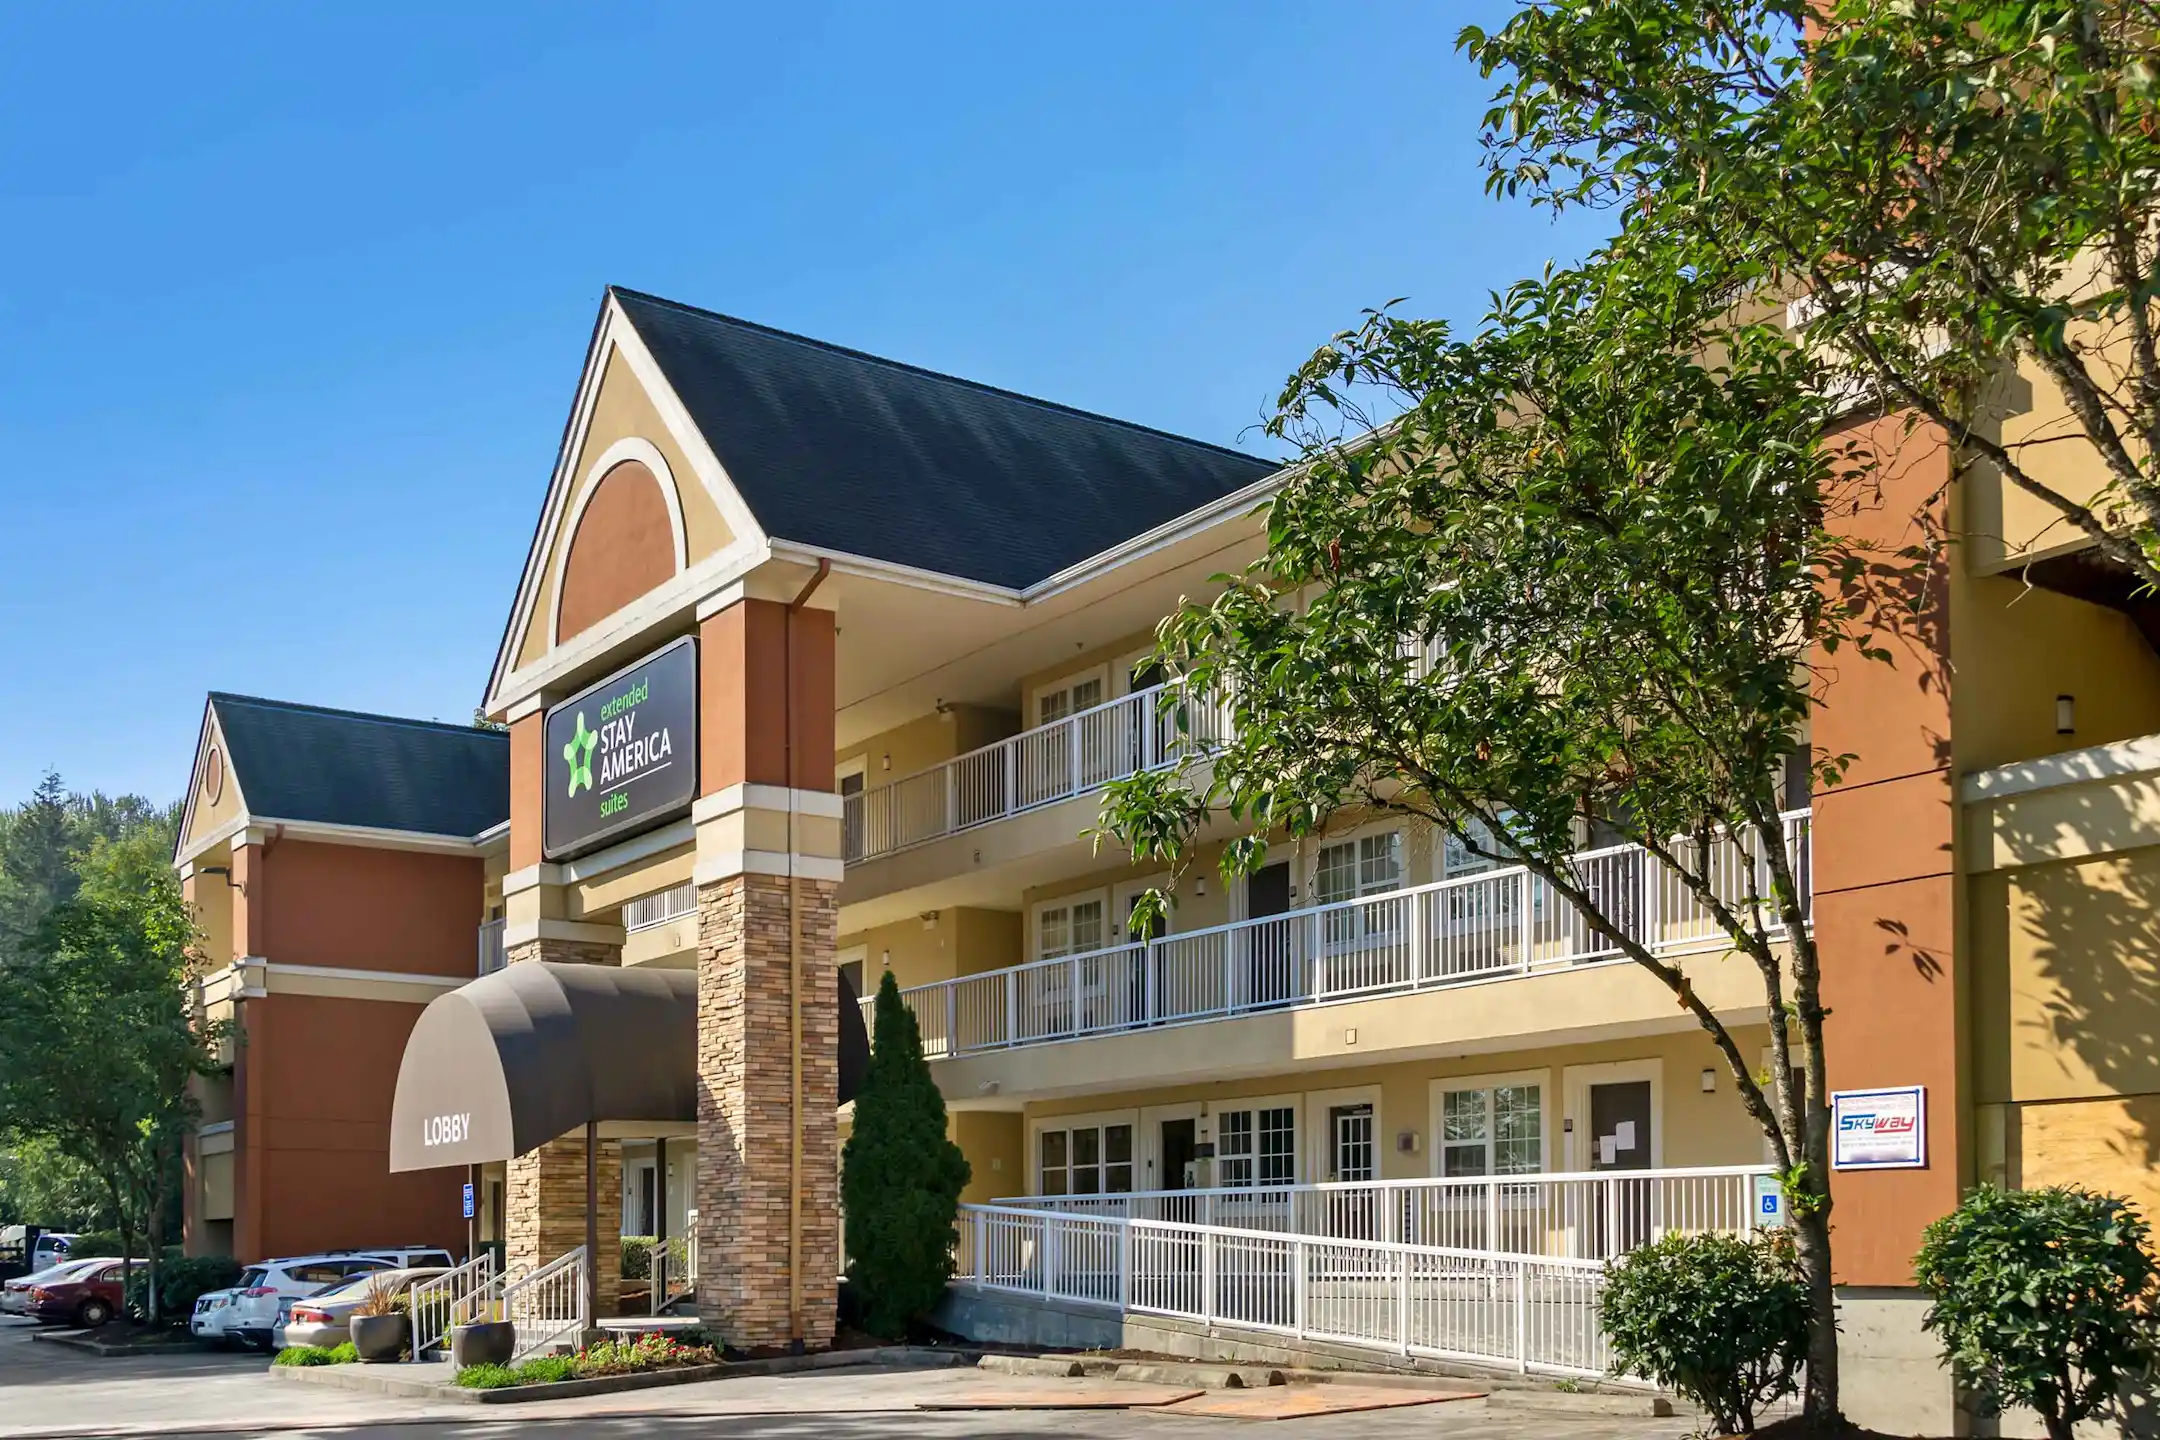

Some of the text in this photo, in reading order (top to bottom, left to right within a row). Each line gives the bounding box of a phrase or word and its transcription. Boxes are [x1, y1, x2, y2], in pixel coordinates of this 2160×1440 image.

[600, 677, 648, 720] extended
[600, 711, 636, 754] STAY
[600, 727, 672, 785] AMERICA
[600, 792, 629, 818] suites
[424, 1112, 471, 1146] LOBBY
